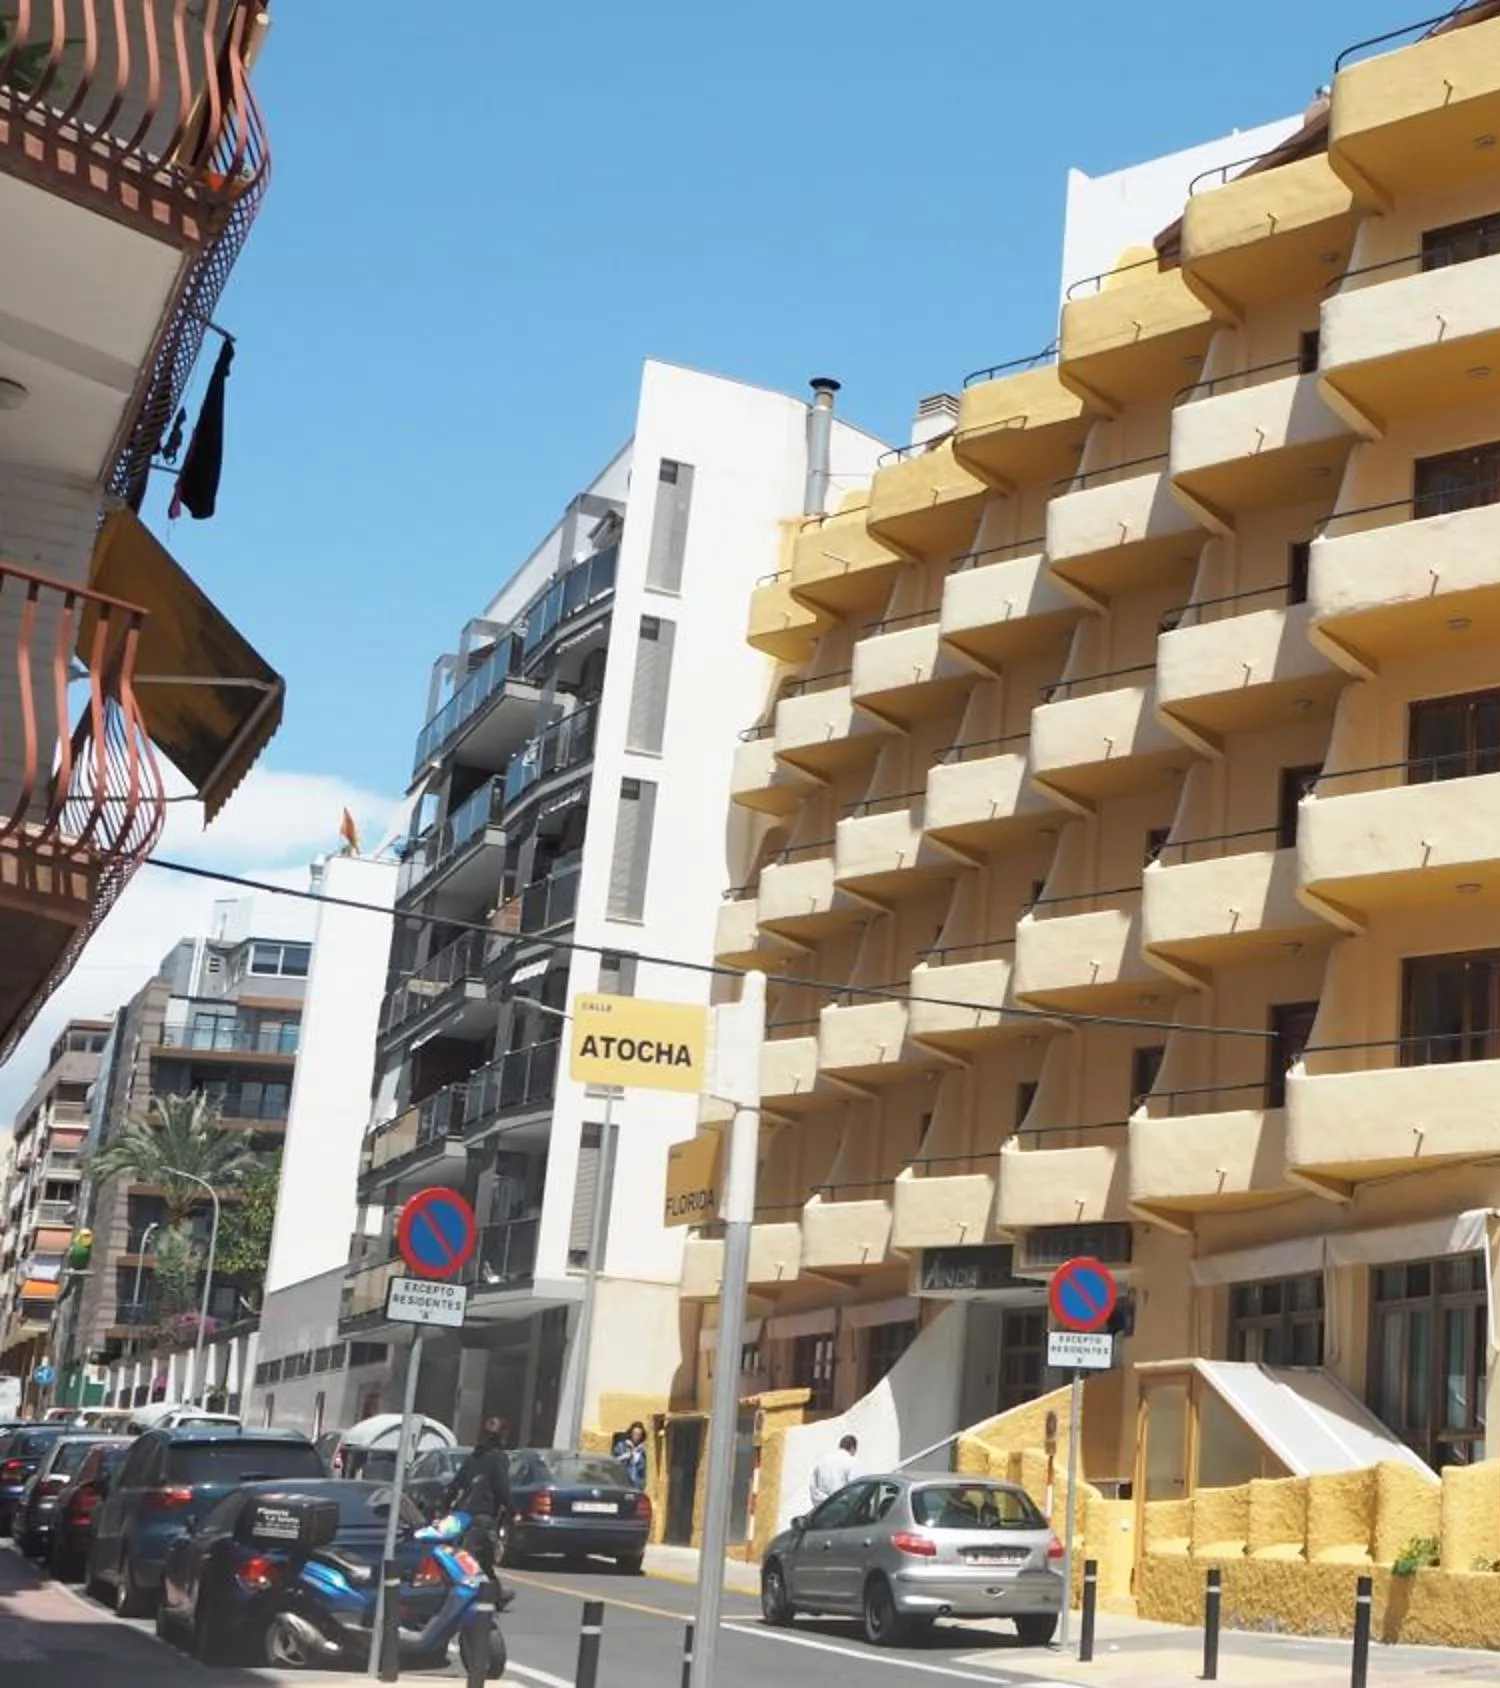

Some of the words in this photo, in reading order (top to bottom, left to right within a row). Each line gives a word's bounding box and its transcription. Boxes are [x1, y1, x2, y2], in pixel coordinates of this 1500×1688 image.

[579, 1034, 692, 1067] ATOCHA
[666, 1189, 715, 1217] FLORIDA
[404, 1281, 454, 1297] EXCEPTO
[393, 1293, 462, 1311] RESIDENTES
